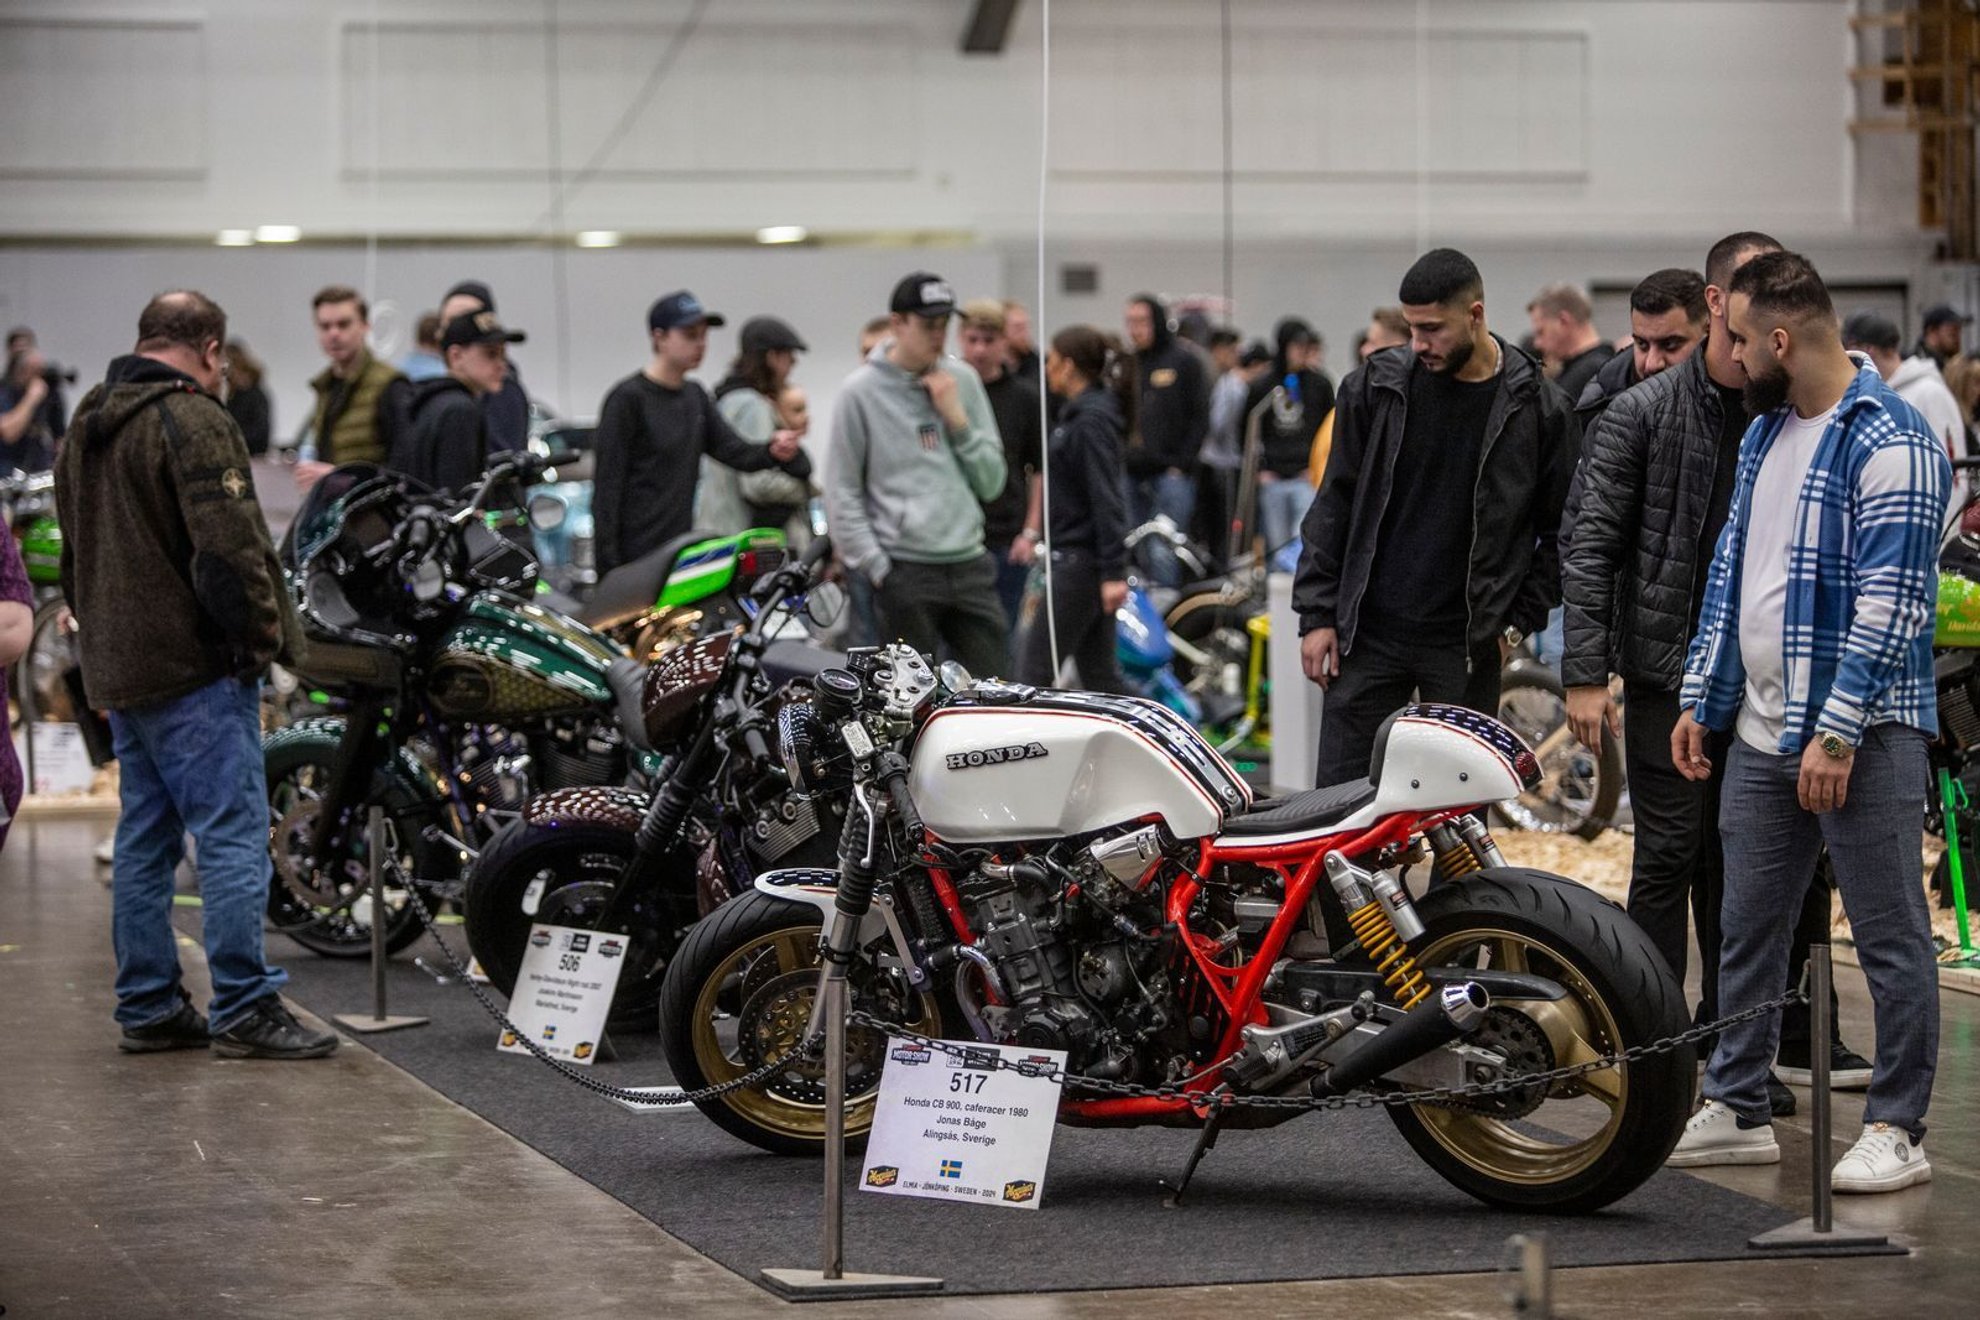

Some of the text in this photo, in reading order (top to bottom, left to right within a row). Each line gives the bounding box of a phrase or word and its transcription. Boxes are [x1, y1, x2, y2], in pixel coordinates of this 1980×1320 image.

[946, 742, 1049, 769] HONDA
[559, 954, 581, 972] 506
[950, 1072, 988, 1094] 517
[904, 1096, 1029, 1118] Honda CB 900, caferacer 1980
[936, 1115, 961, 1126] Jonas
[962, 1132, 996, 1147] Sverige
[903, 1180, 918, 1189] ELMIA
[954, 1186, 977, 1195] SWEDEN
